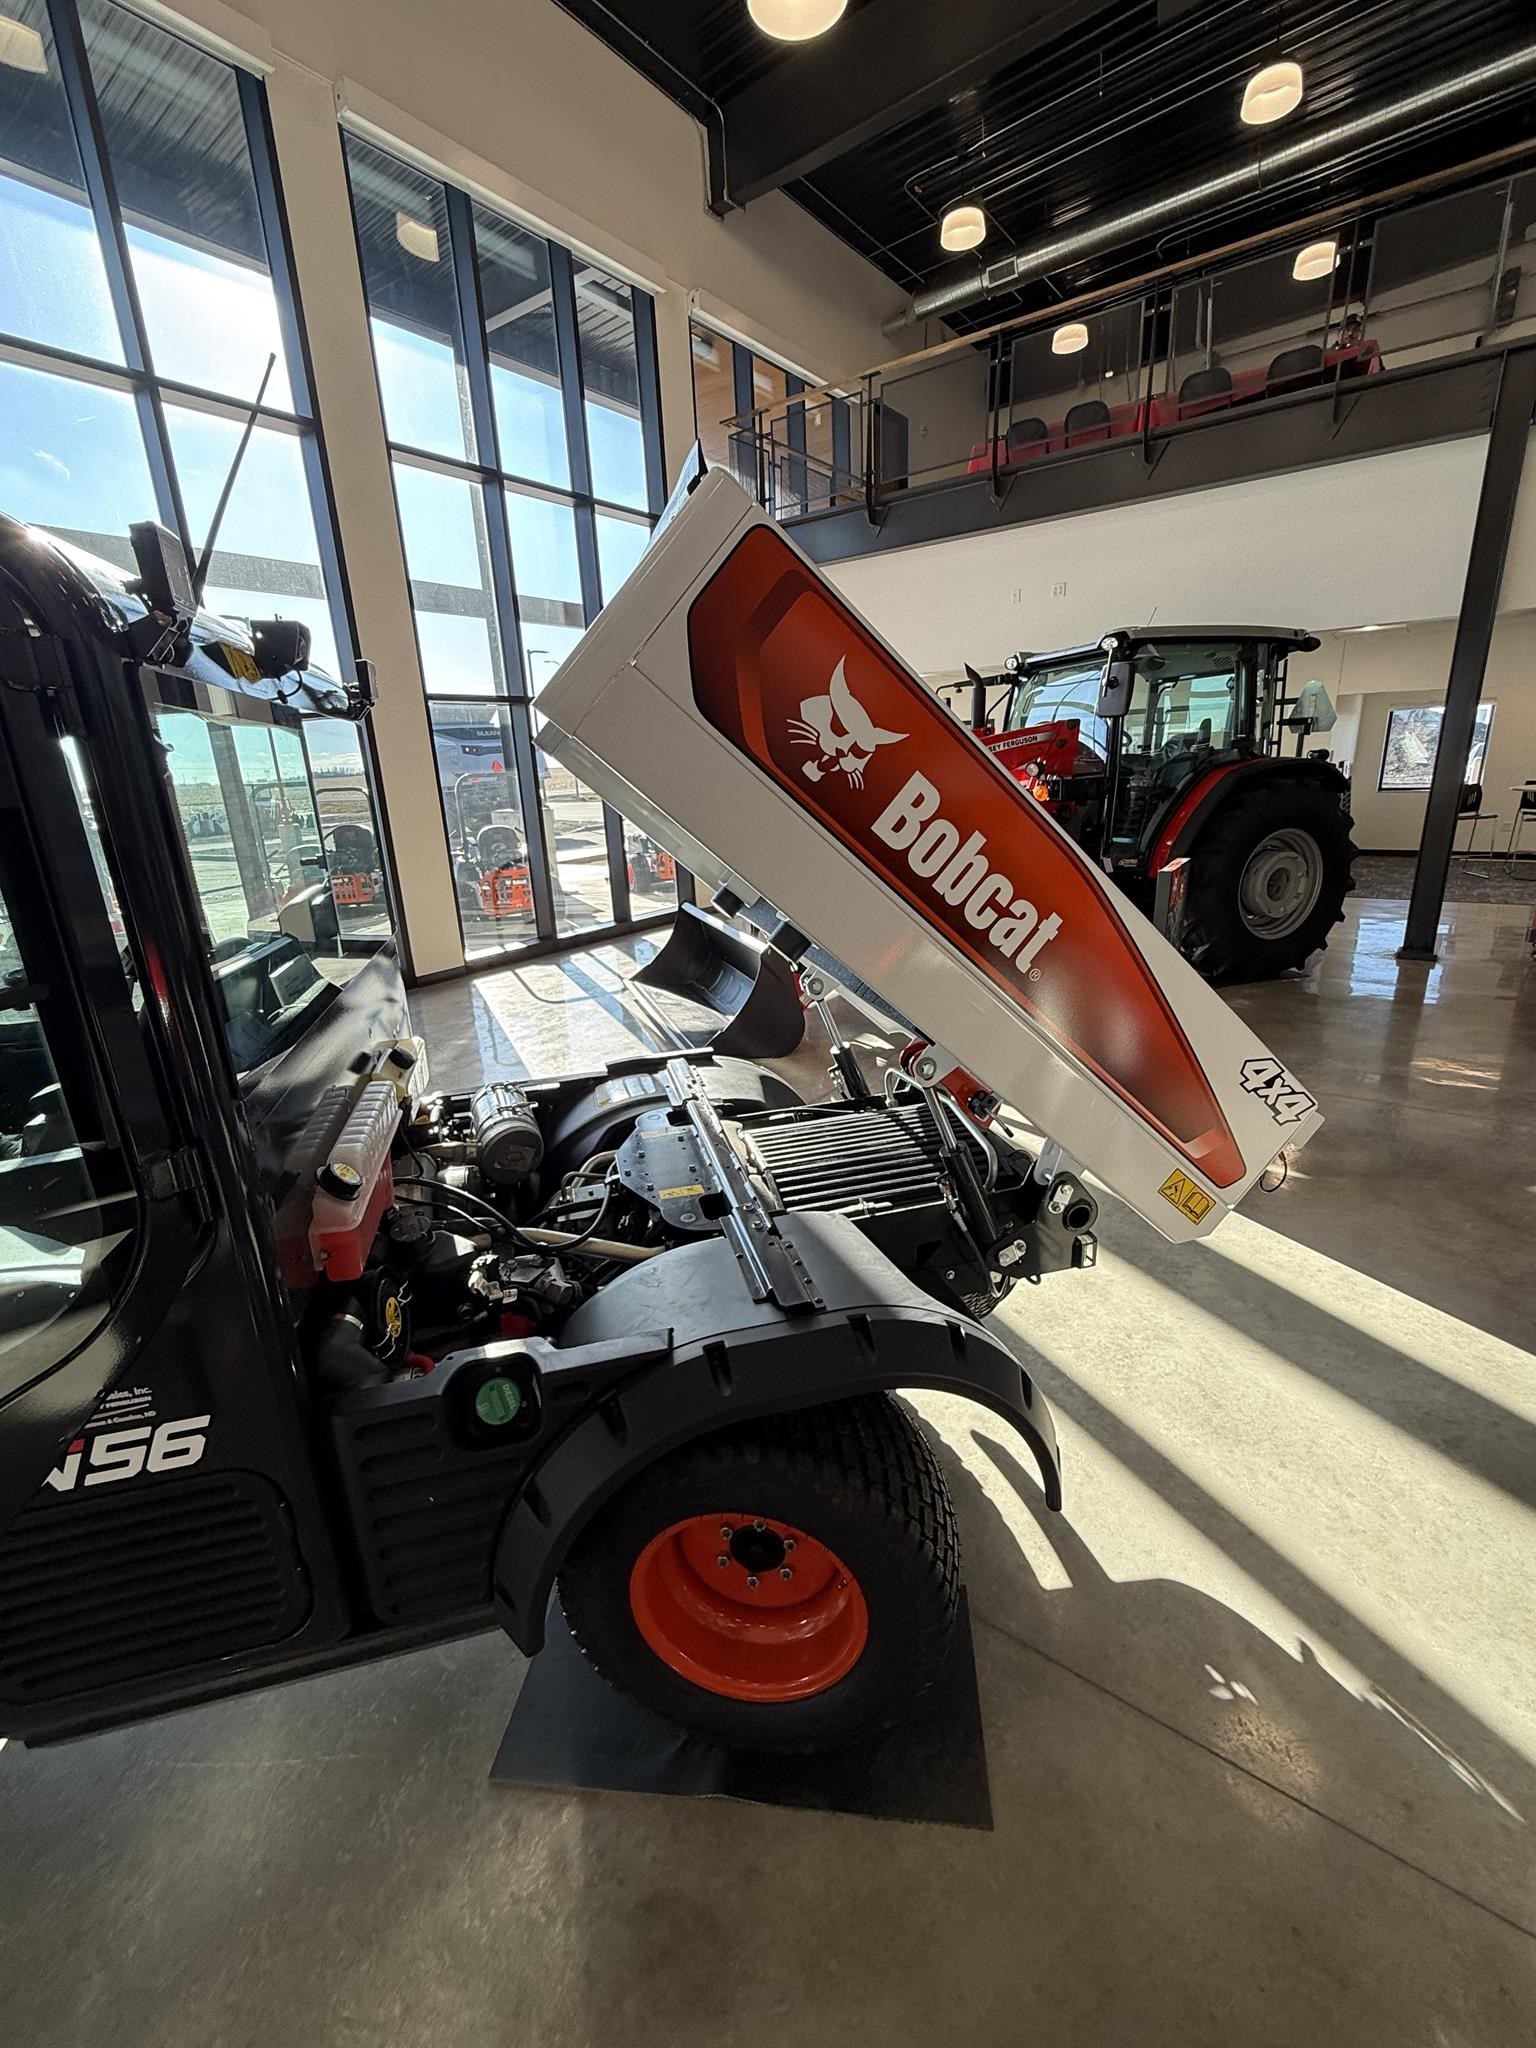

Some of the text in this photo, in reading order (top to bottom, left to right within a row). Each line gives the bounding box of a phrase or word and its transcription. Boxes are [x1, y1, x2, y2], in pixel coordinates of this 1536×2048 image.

[1003, 736, 1038, 748] FERGUSON
[871, 770, 1064, 974] Bobcat
[105, 1390, 133, 1401] ales,
